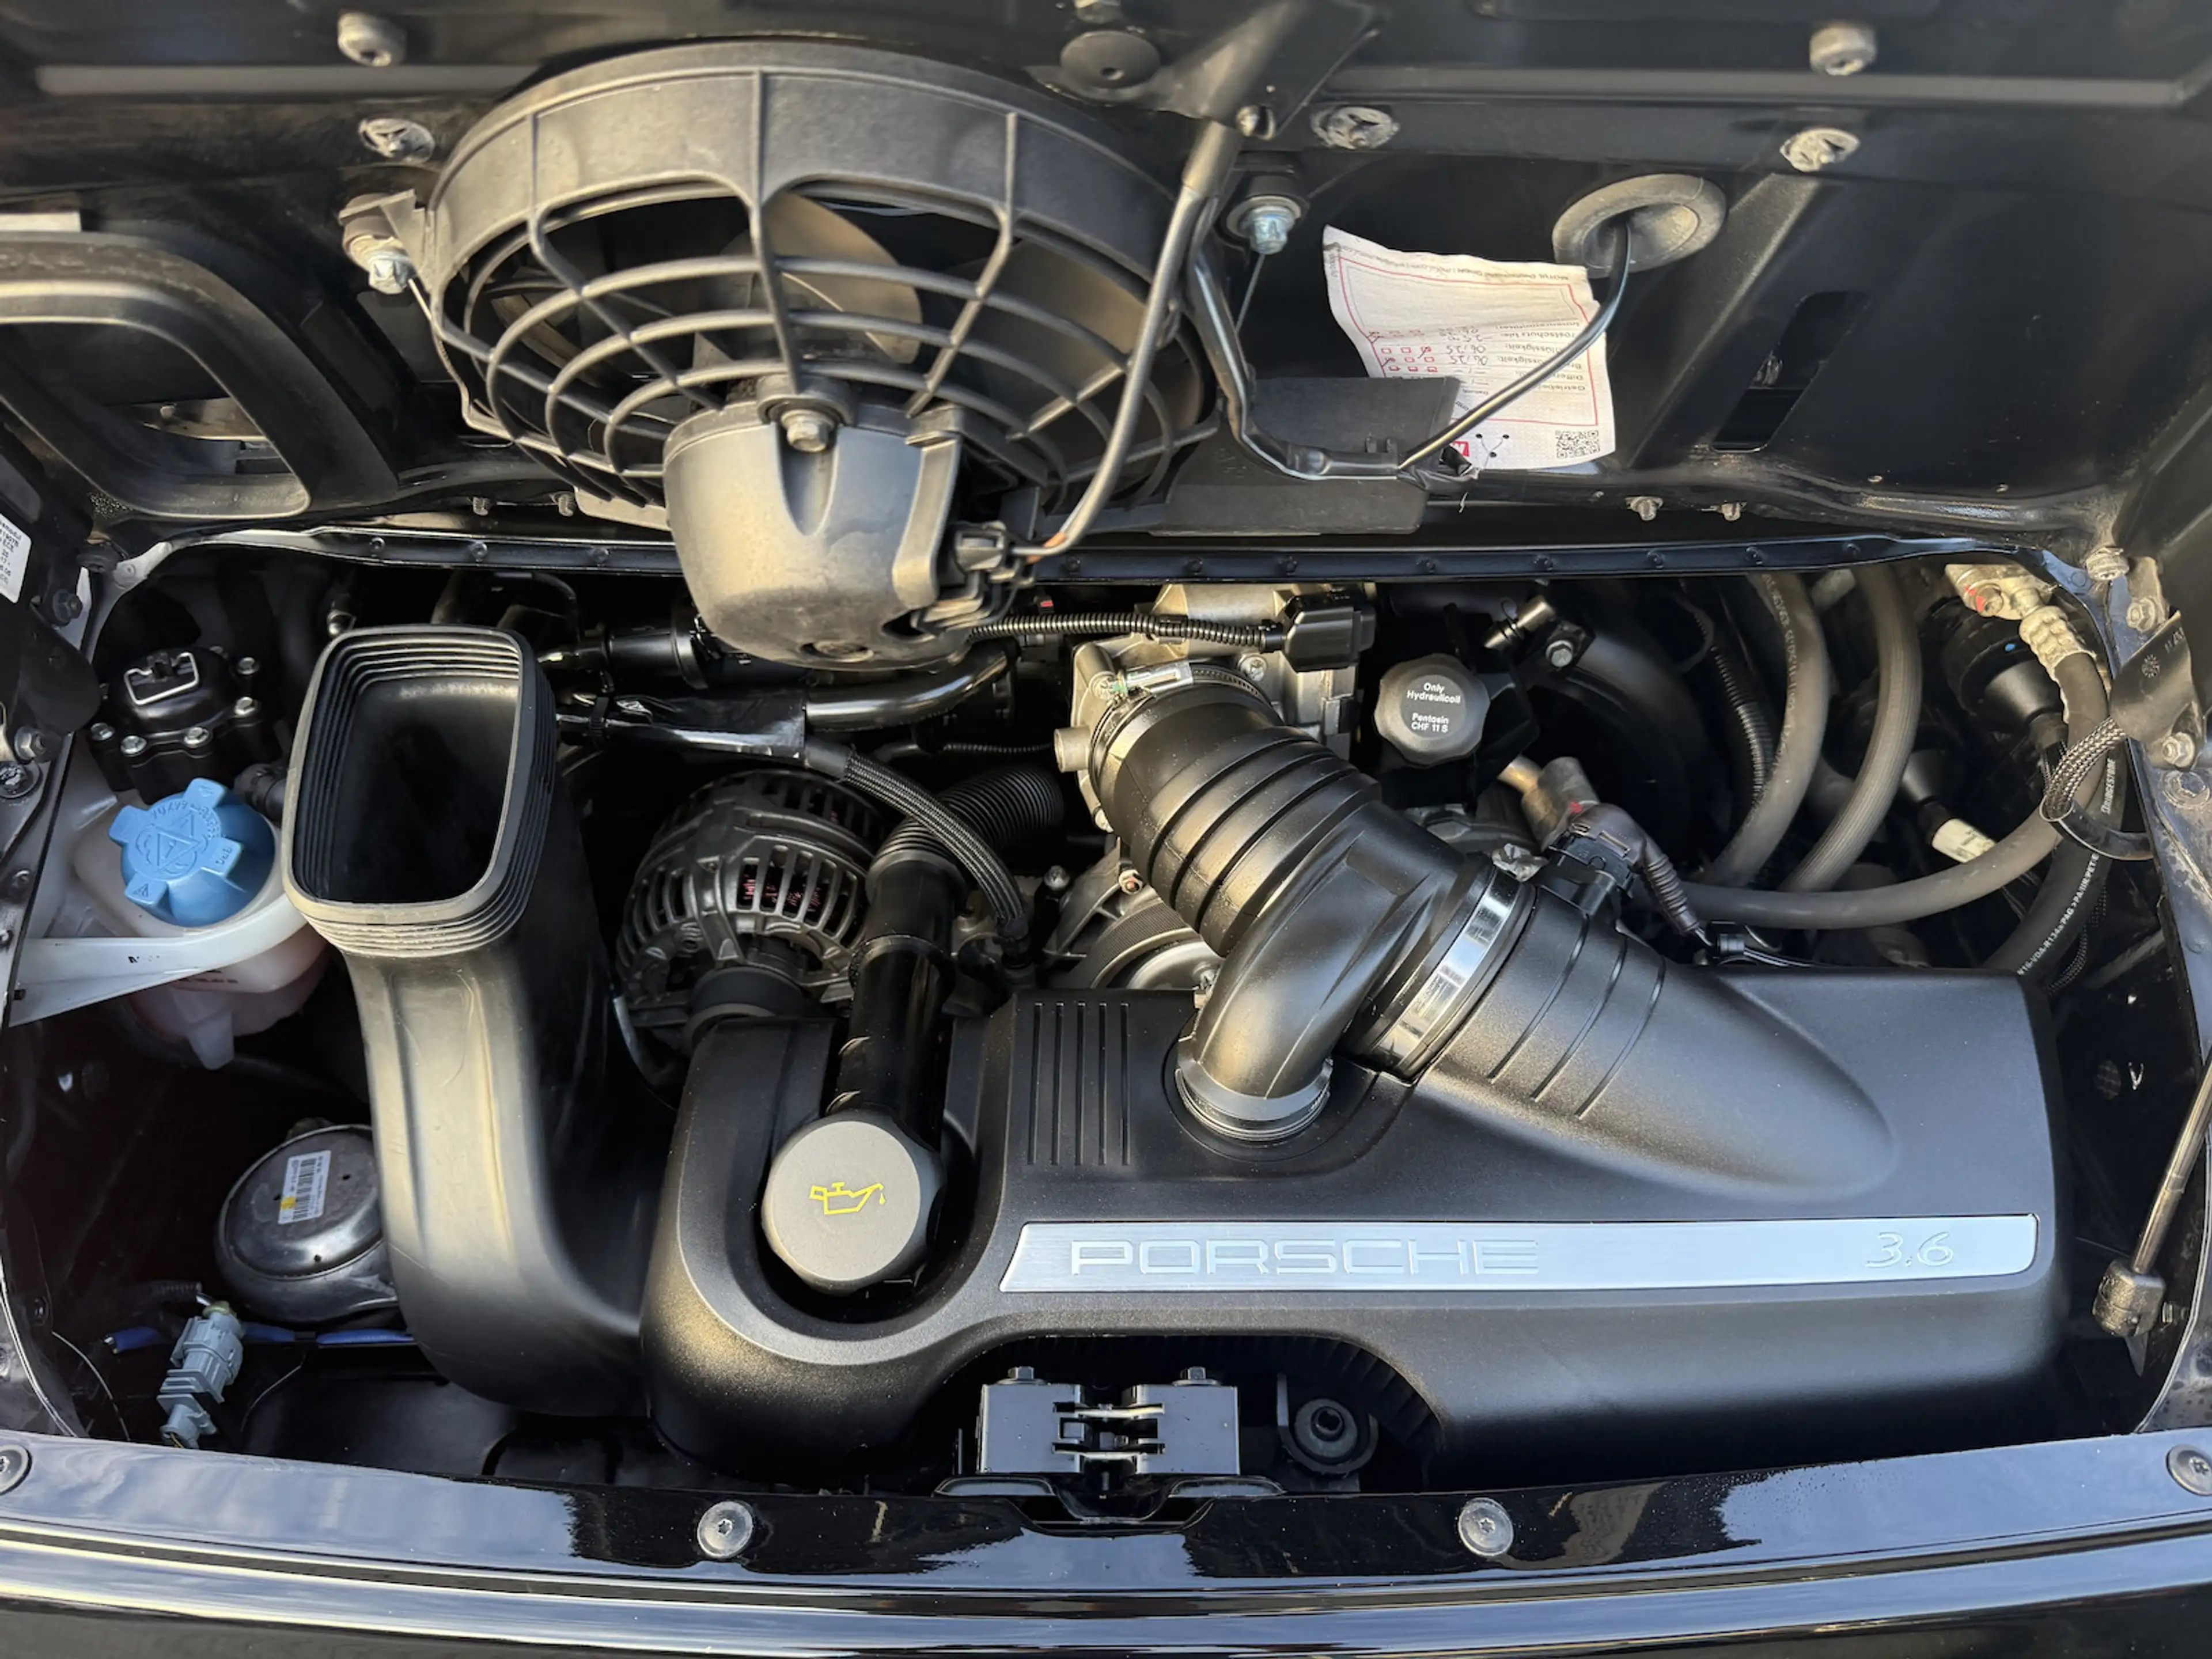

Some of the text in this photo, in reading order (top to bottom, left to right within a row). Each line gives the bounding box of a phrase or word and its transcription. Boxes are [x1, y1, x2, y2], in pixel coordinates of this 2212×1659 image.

[1423, 683, 1445, 694] Only
[1411, 713, 1449, 725] Pentosin
[1411, 721, 1449, 733] CHF 11 S
[1070, 1231, 1954, 1275] PORSCHE 3.6
